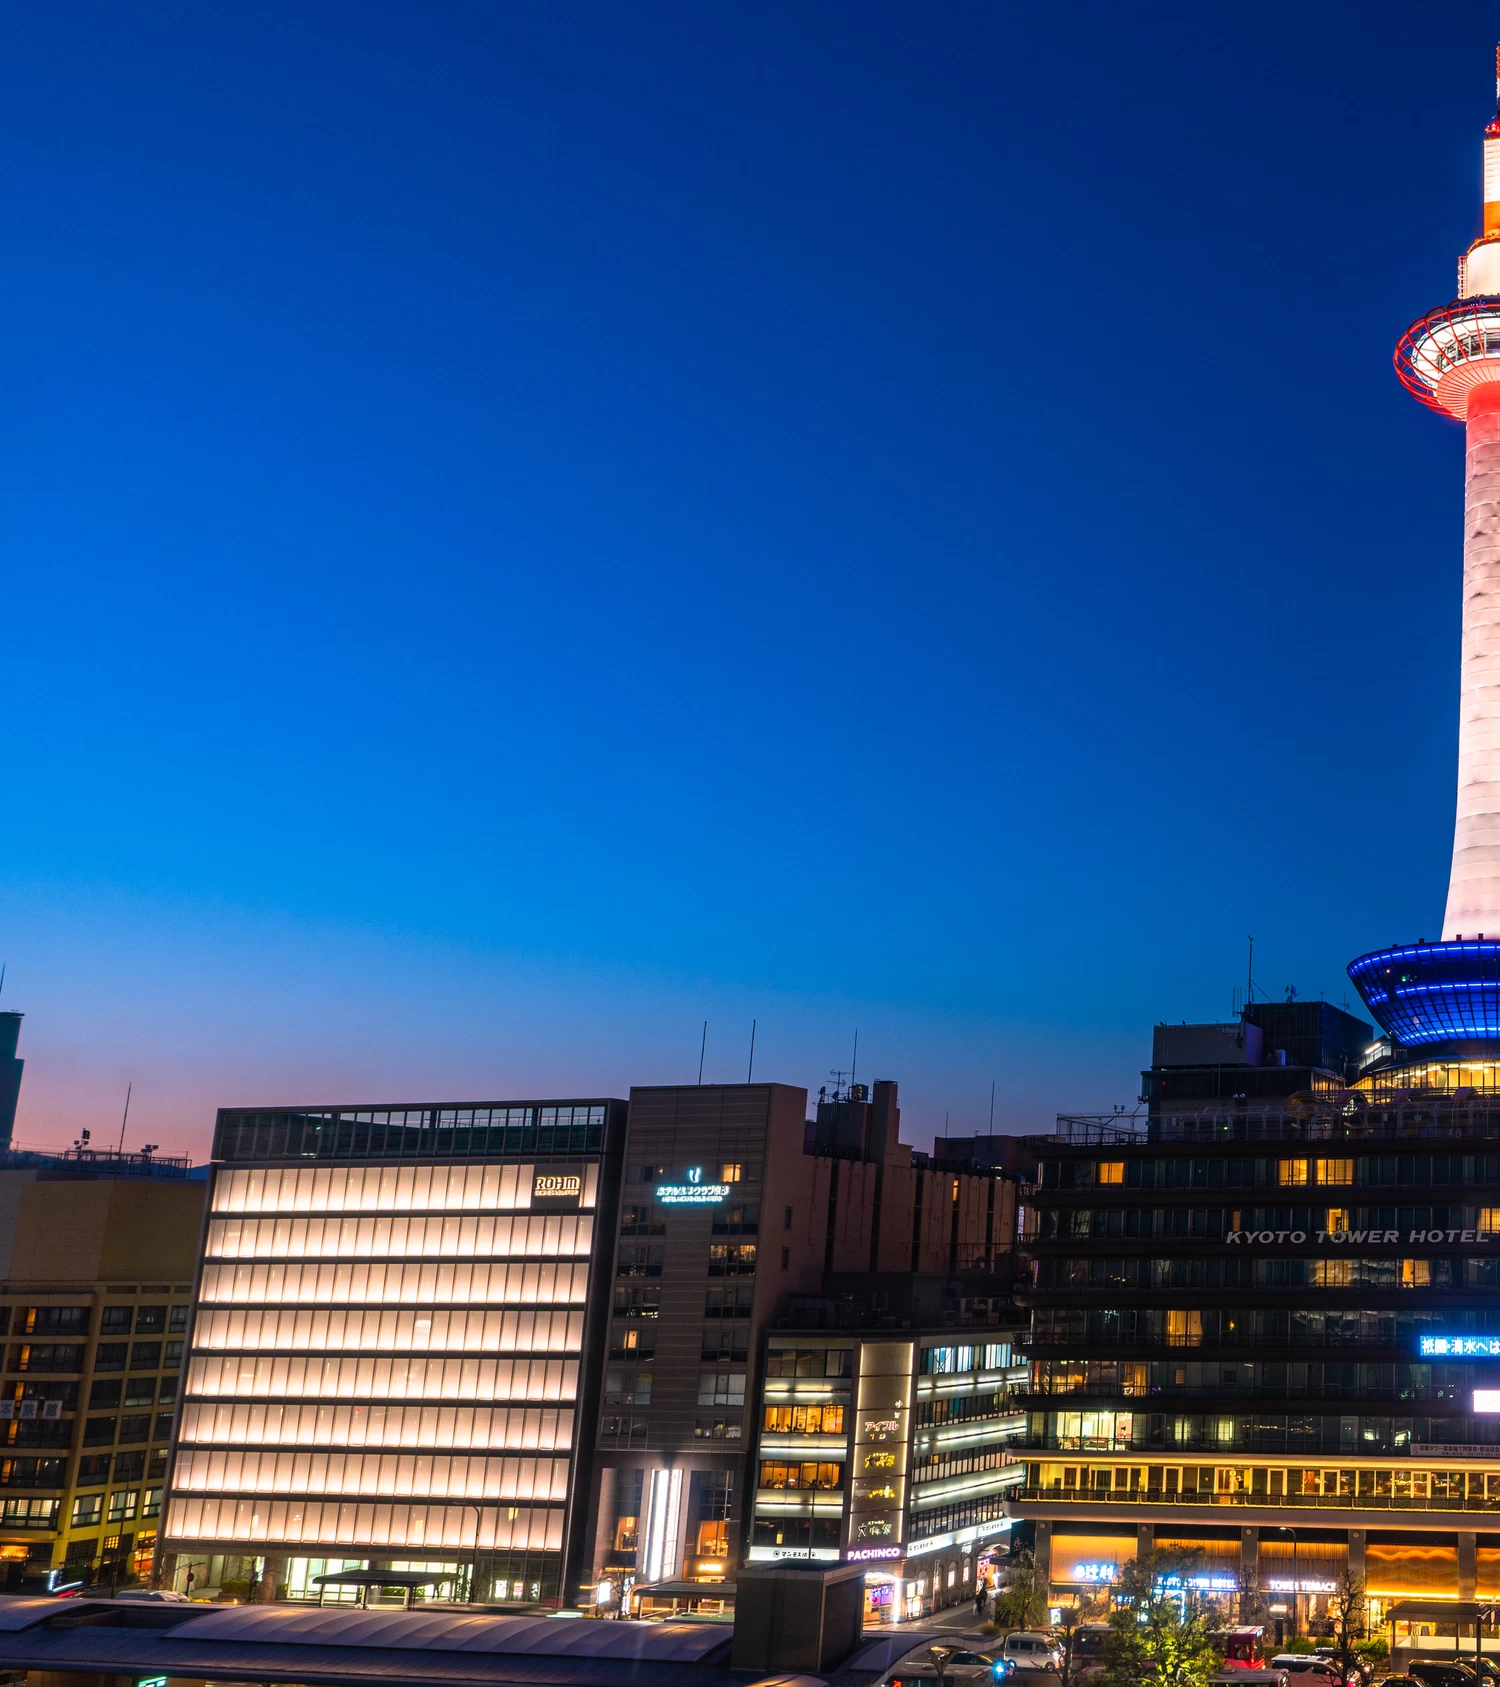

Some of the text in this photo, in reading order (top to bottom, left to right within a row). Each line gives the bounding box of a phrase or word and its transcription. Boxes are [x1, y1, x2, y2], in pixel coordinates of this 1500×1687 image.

[535, 1176, 580, 1190] ROHM
[1226, 1229, 1489, 1244] KYOTO TOWER HOTEL
[1421, 1339, 1500, 1356] 祇園・清水へは
[864, 1420, 900, 1432] アイフル
[847, 1548, 900, 1560] PACHINCO
[1269, 1580, 1336, 1592] TOWER TERRACE
